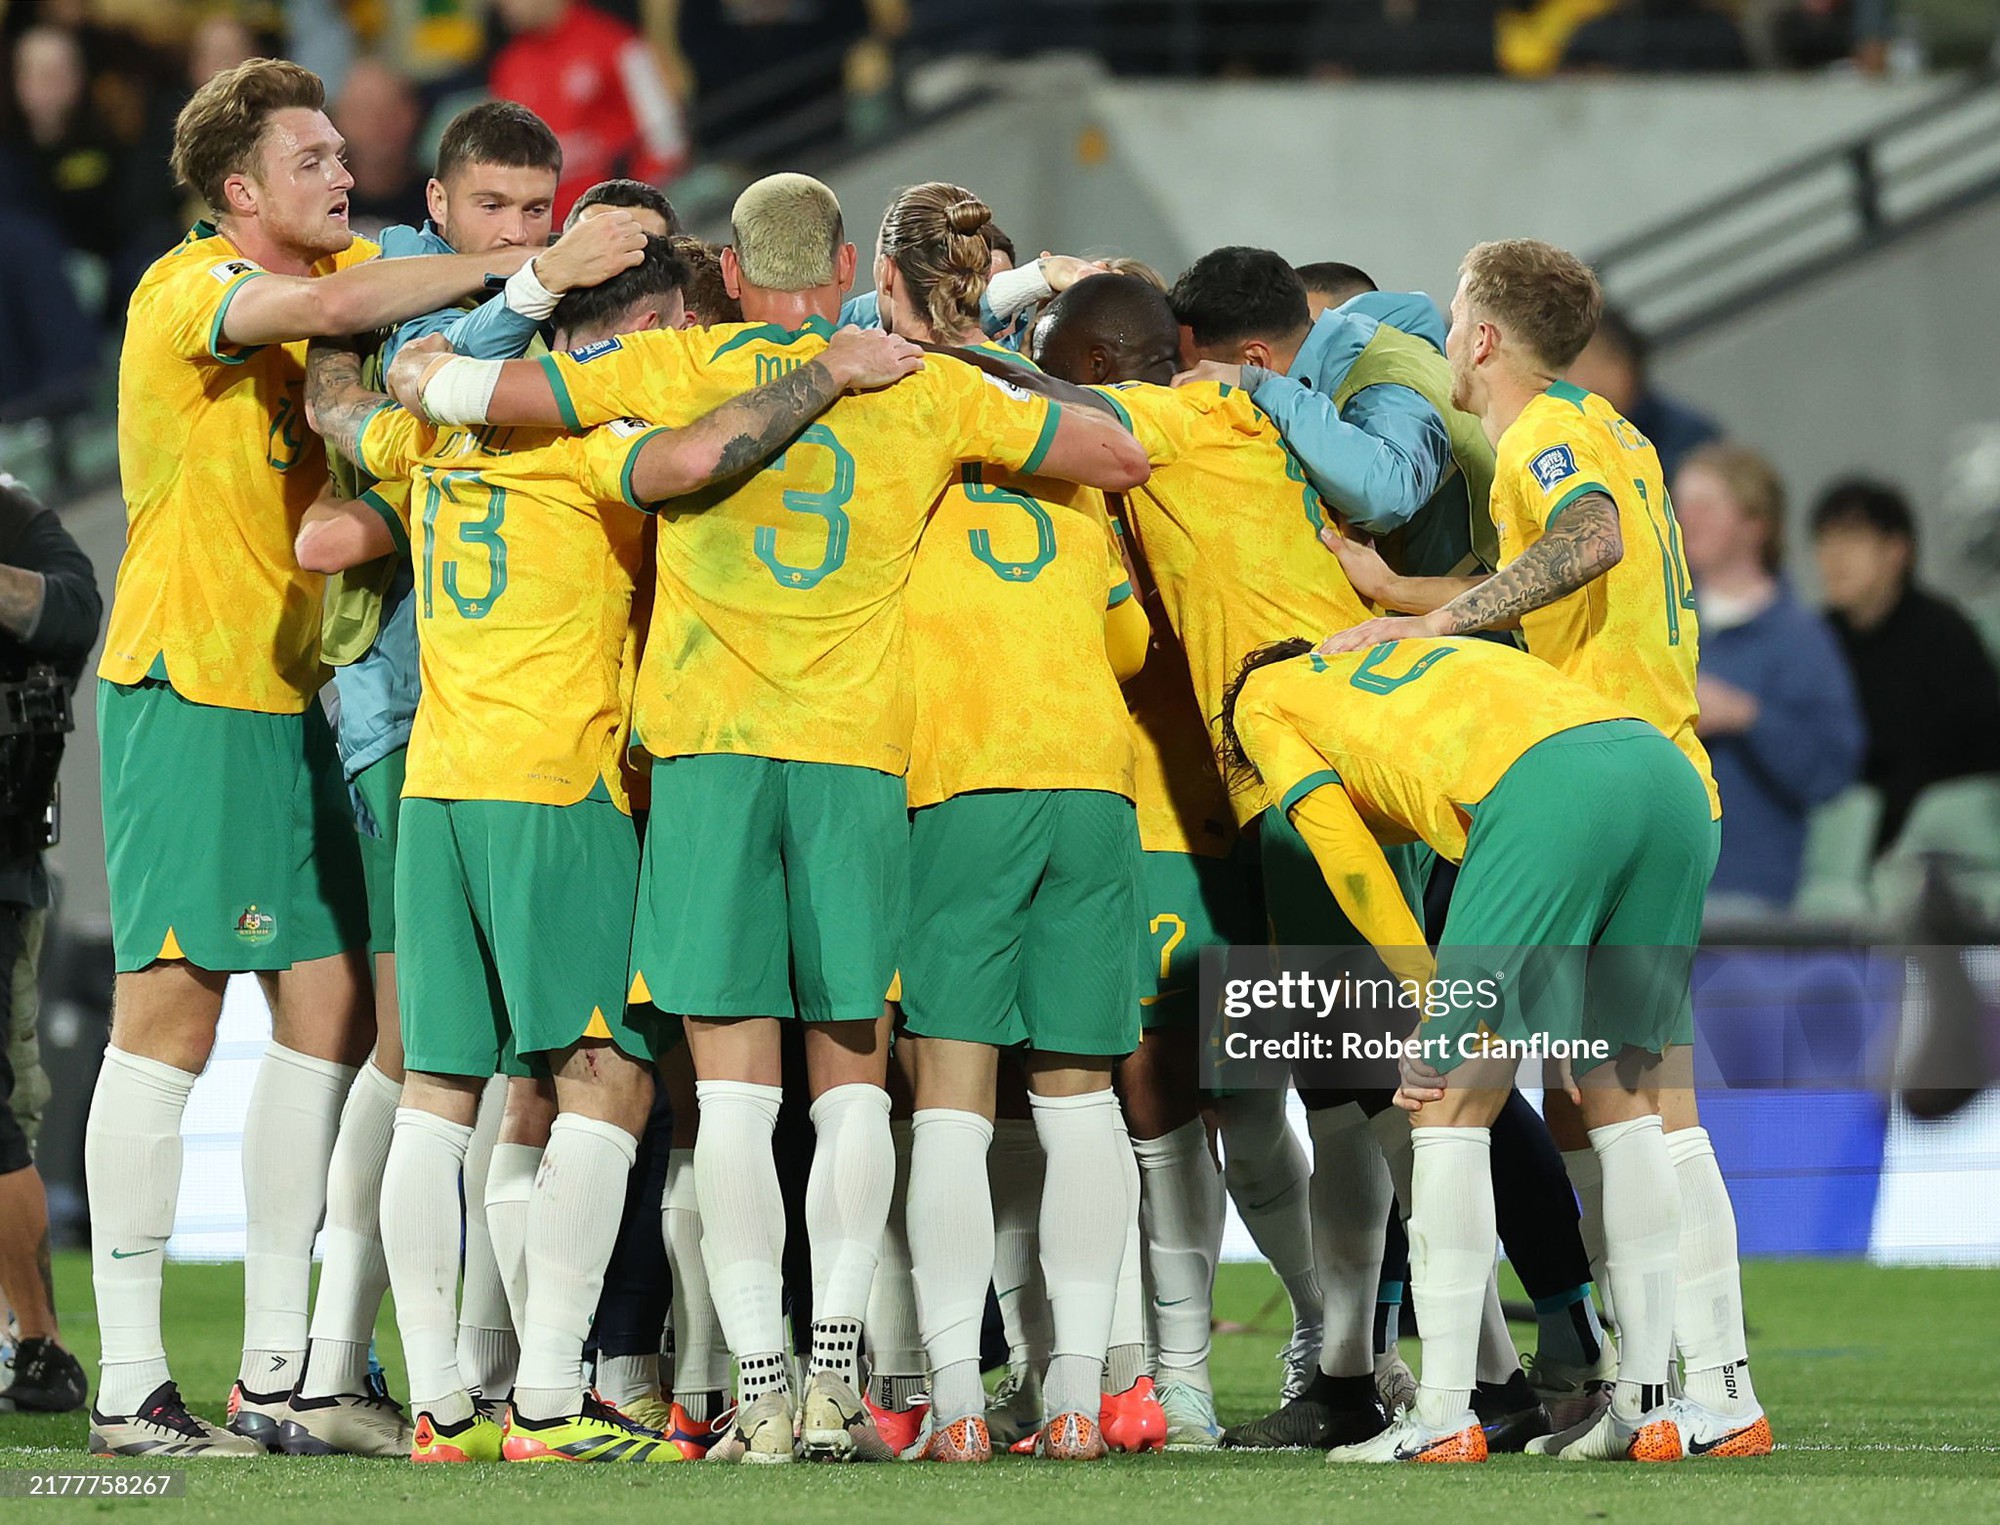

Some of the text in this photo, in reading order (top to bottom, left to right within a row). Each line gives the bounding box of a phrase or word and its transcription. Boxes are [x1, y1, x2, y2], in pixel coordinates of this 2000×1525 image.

[421, 465, 508, 619] 13
[753, 423, 856, 590] 3
[960, 461, 1057, 582] 5
[1149, 913, 1186, 979] 7
